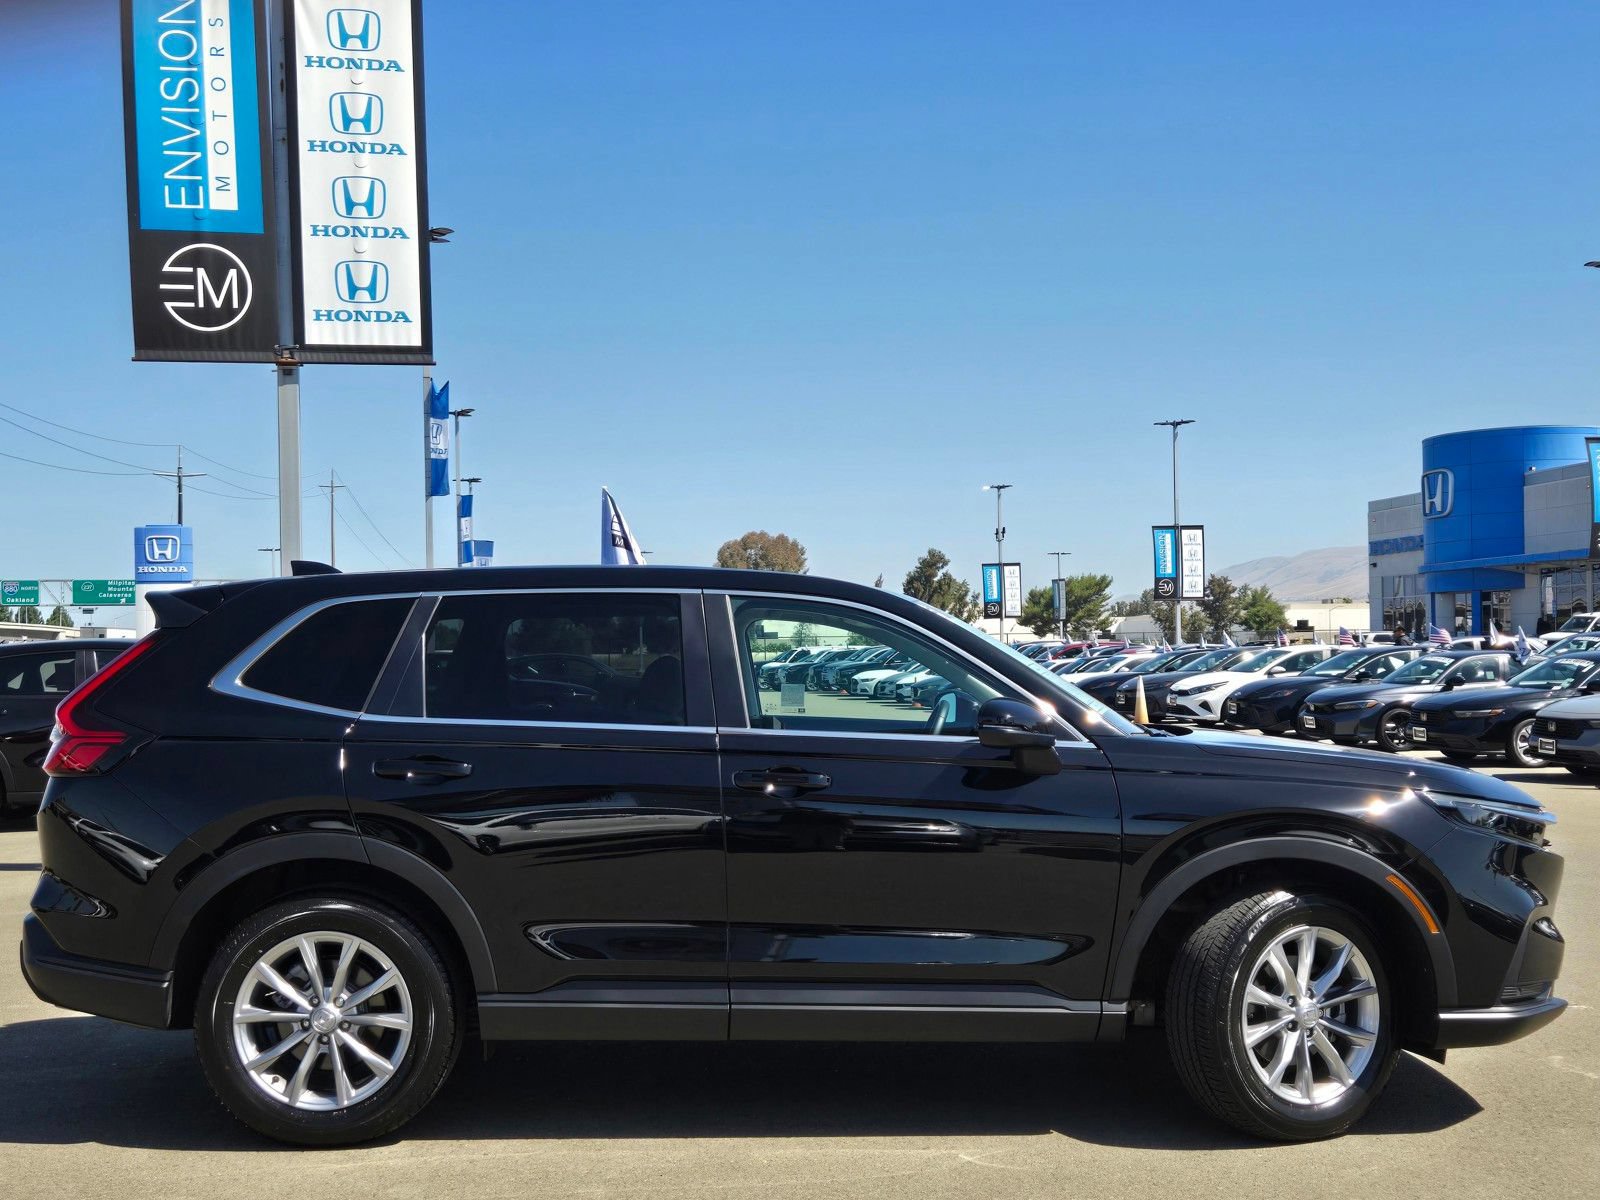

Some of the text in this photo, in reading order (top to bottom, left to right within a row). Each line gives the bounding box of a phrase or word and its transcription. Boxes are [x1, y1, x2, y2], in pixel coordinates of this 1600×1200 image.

[304, 55, 405, 73] HONDA
[158, 0, 205, 210] ENVISION
[208, 17, 231, 192] MOTORS
[307, 140, 407, 156] HONDA
[310, 224, 410, 240] HONDA
[312, 309, 413, 324] HONDA
